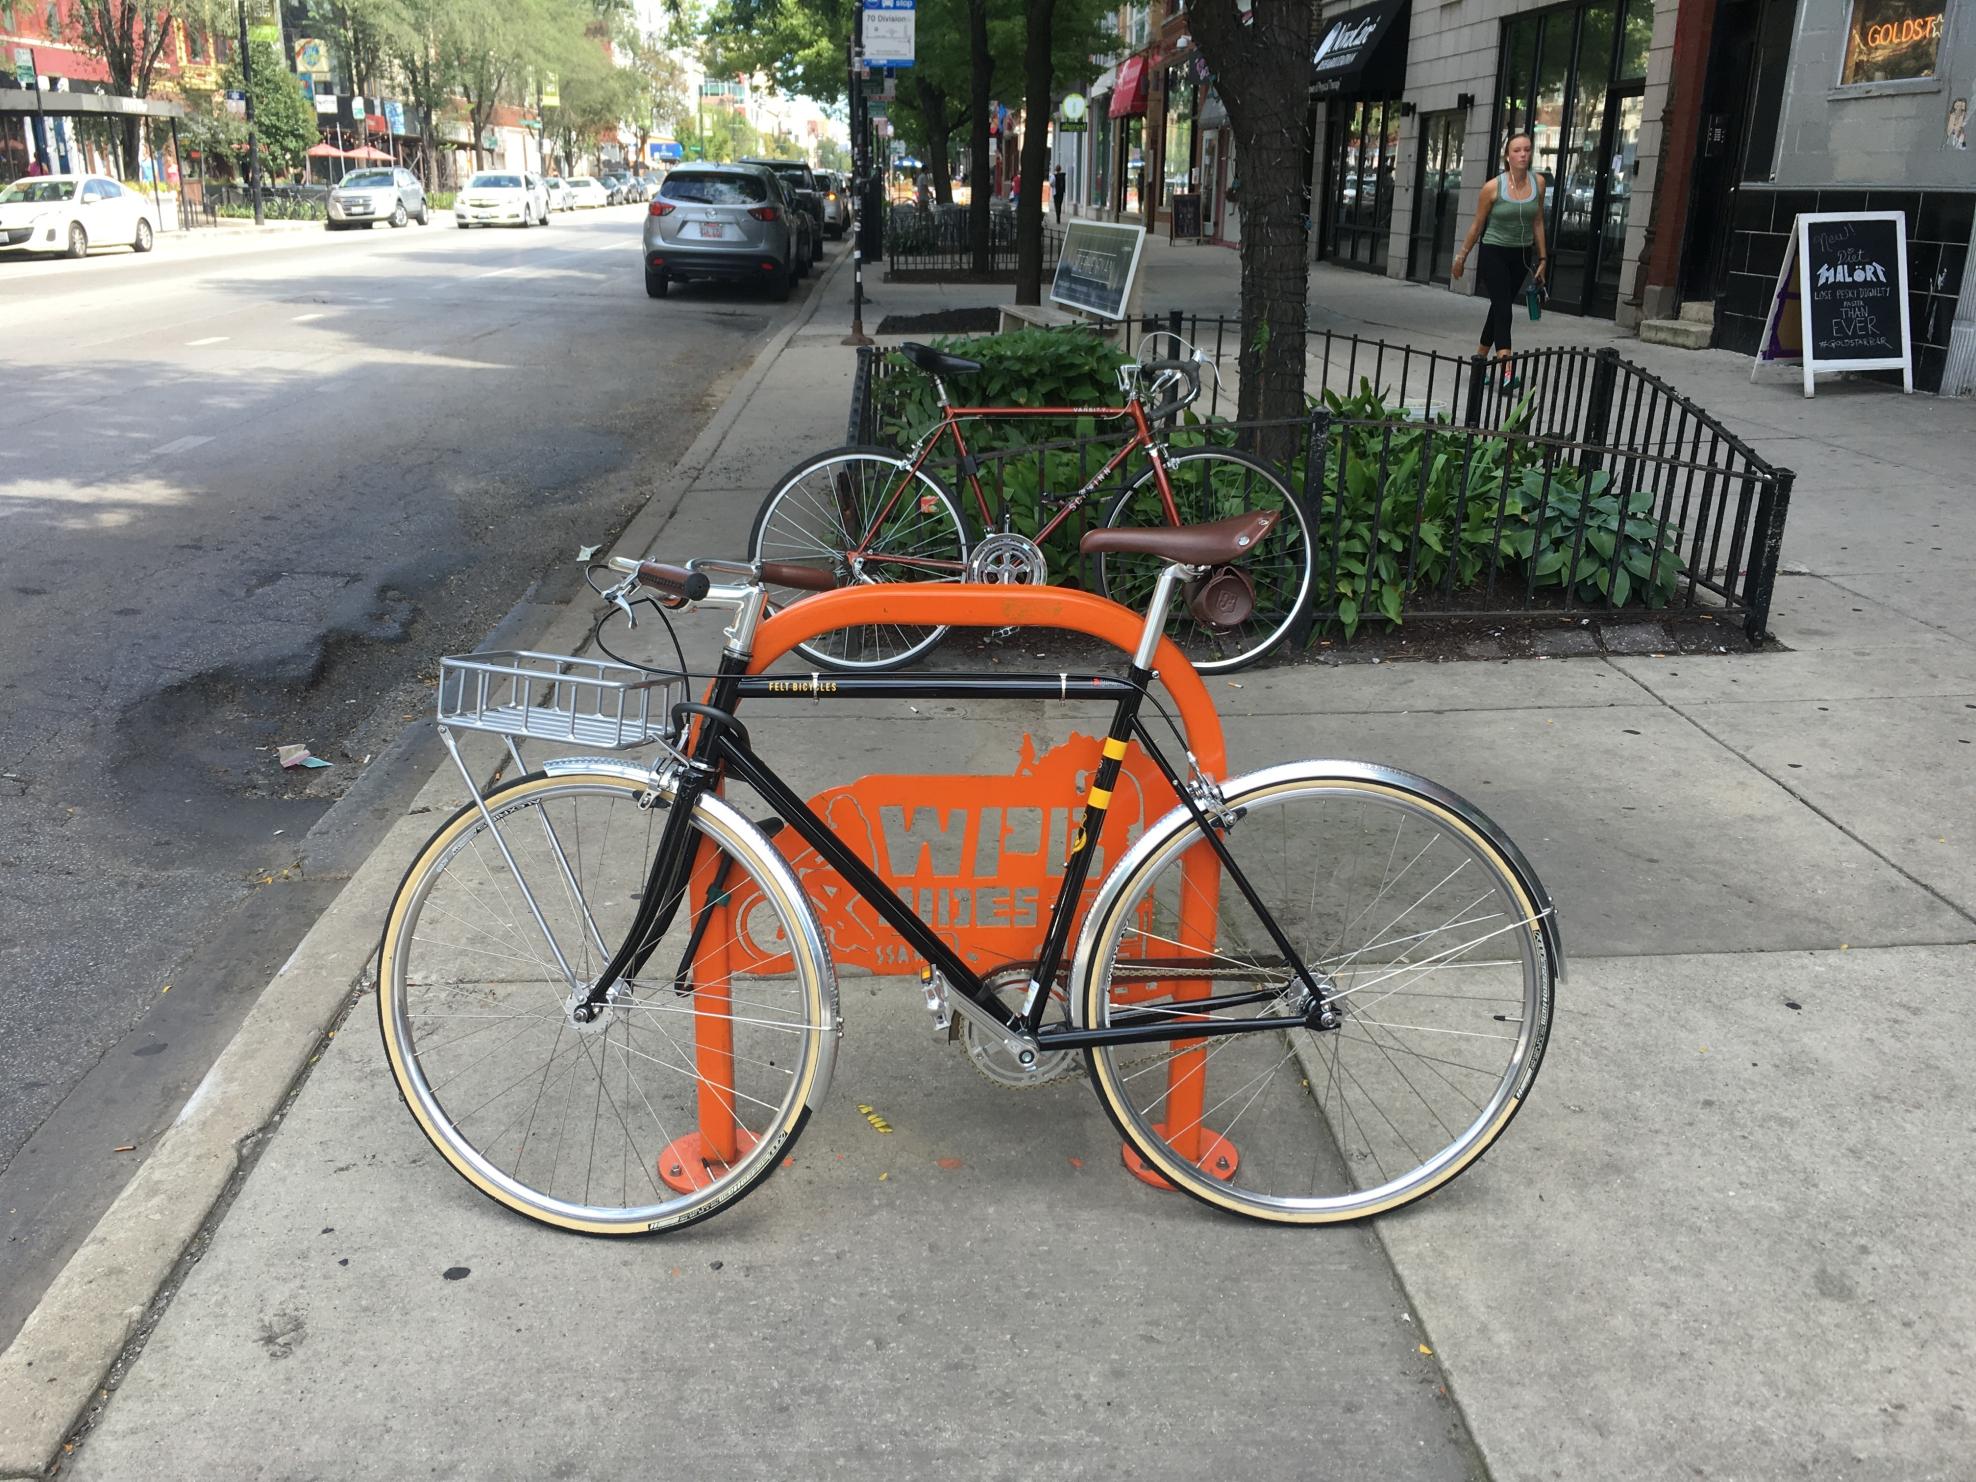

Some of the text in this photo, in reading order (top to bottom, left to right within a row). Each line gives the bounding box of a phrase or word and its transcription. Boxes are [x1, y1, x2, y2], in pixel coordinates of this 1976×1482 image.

[866, 14, 906, 23] 70 Division
[1837, 247, 1866, 264] Diet
[1814, 287, 1891, 300] LOSE PESKY DIGNITY
[1840, 305, 1868, 319] THAN
[1832, 315, 1880, 337] EVER
[769, 682, 837, 692] FELT BICYCLES
[875, 945, 910, 964] SSA
